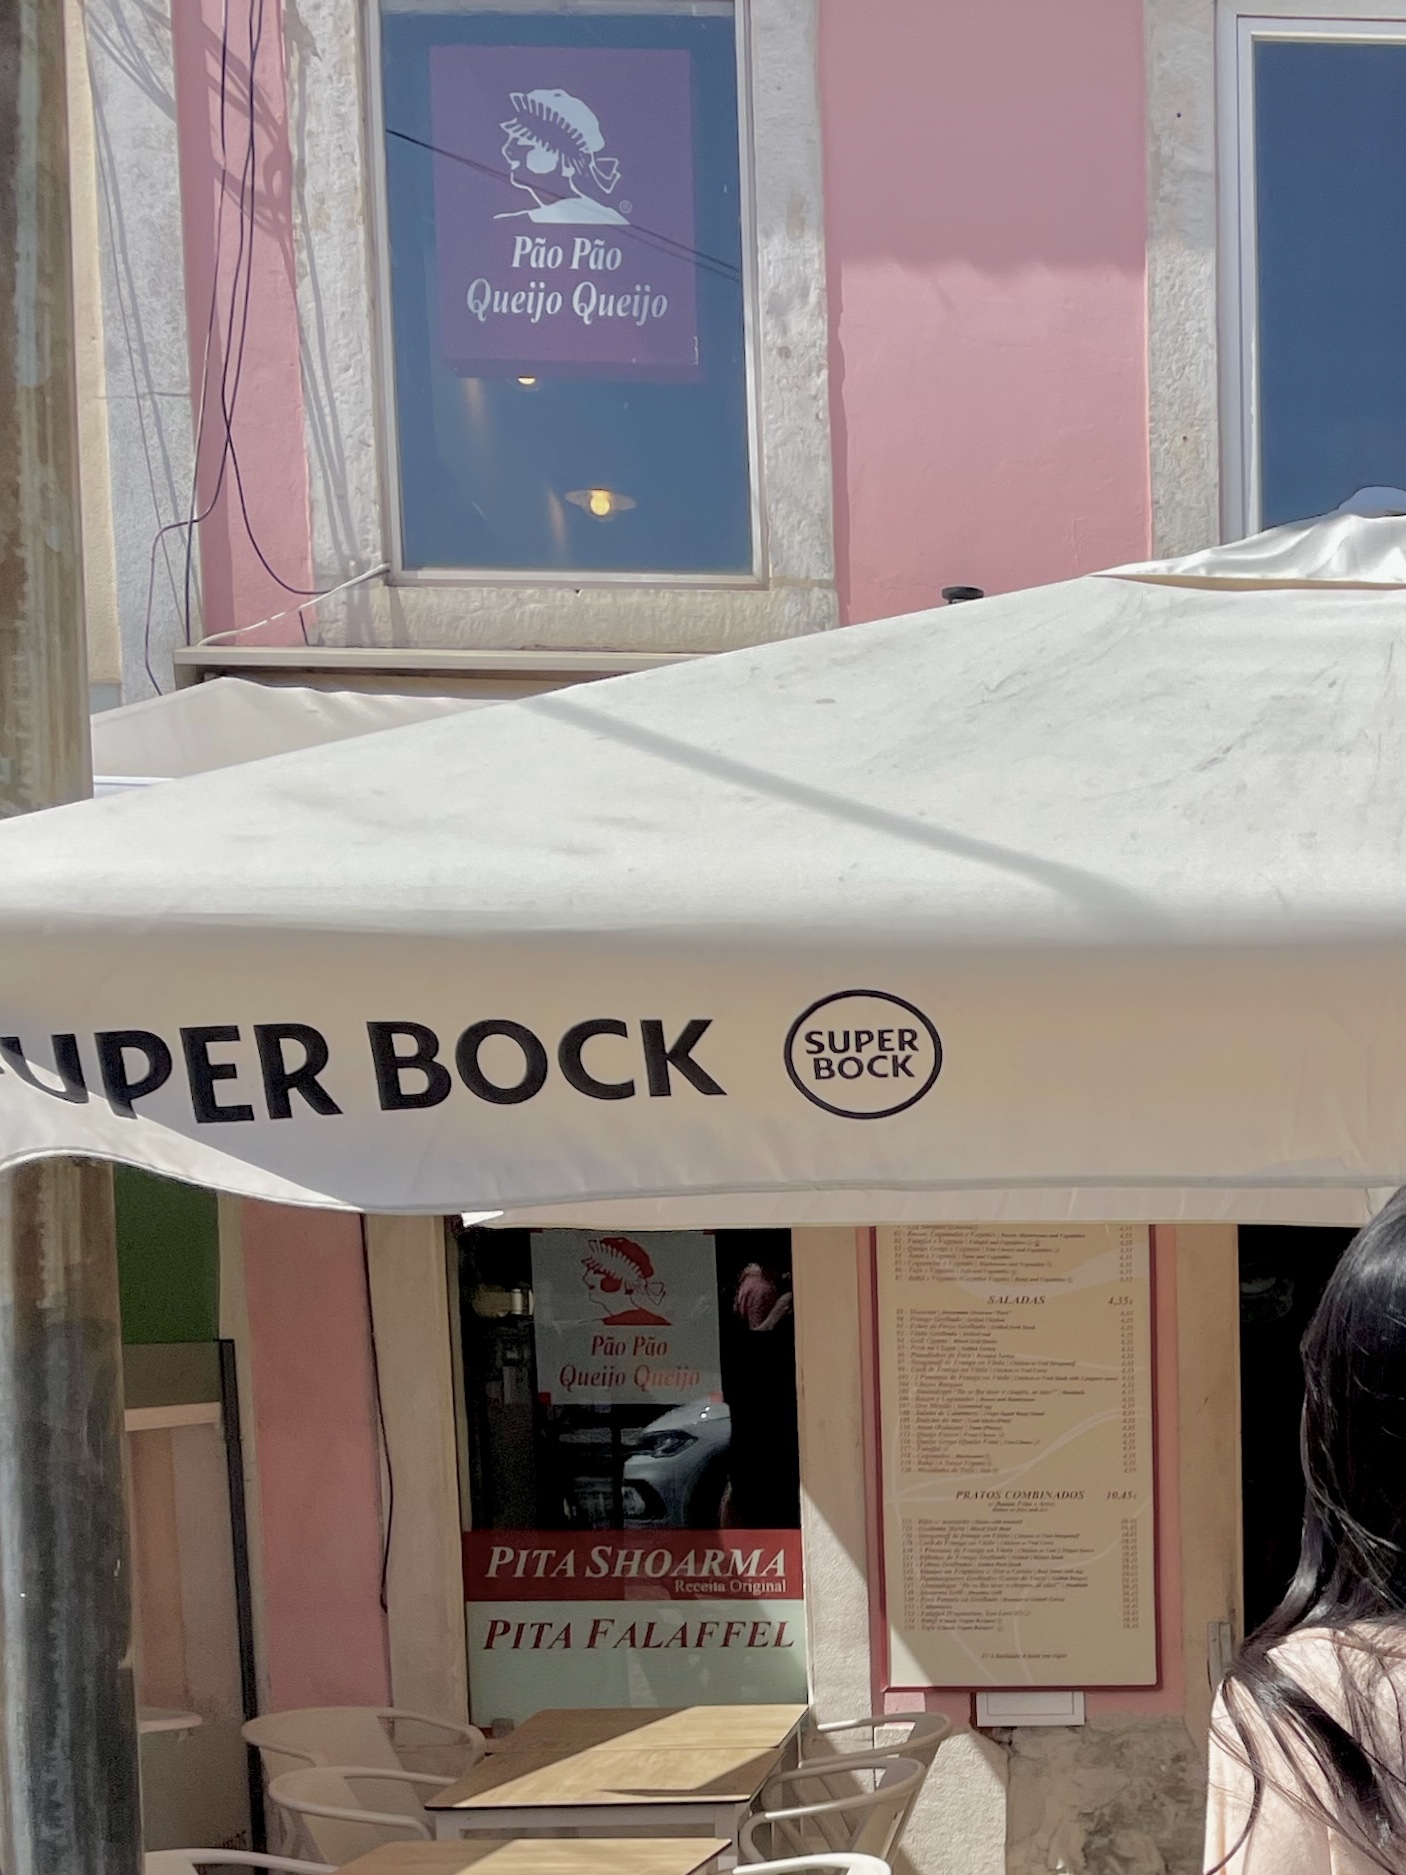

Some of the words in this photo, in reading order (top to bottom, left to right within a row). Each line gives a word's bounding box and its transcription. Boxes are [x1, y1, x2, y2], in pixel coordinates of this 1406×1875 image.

[511, 235, 563, 270] Pão
[570, 237, 622, 271] Pão
[466, 278, 562, 323] Queijo
[572, 281, 668, 326] Queijo
[804, 1028, 919, 1055] SUPER
[0, 1022, 344, 1123] UPER
[366, 1019, 727, 1111] BOCK
[813, 1054, 915, 1080] BOCK
[987, 1295, 1046, 1305] SALADAS
[591, 1335, 626, 1356] Pão
[632, 1335, 668, 1357] Pão
[559, 1364, 626, 1392] Queijo
[633, 1364, 700, 1392] Queijo
[956, 1491, 1001, 1499] PRATOS
[1004, 1491, 1085, 1499] COMBINADOS
[485, 1546, 576, 1578] PITA
[585, 1545, 786, 1579] SHOARMA
[675, 1579, 726, 1593] Receita
[729, 1579, 786, 1596] Original
[484, 1619, 574, 1650] PITA
[586, 1618, 795, 1650] FALAFFEL
